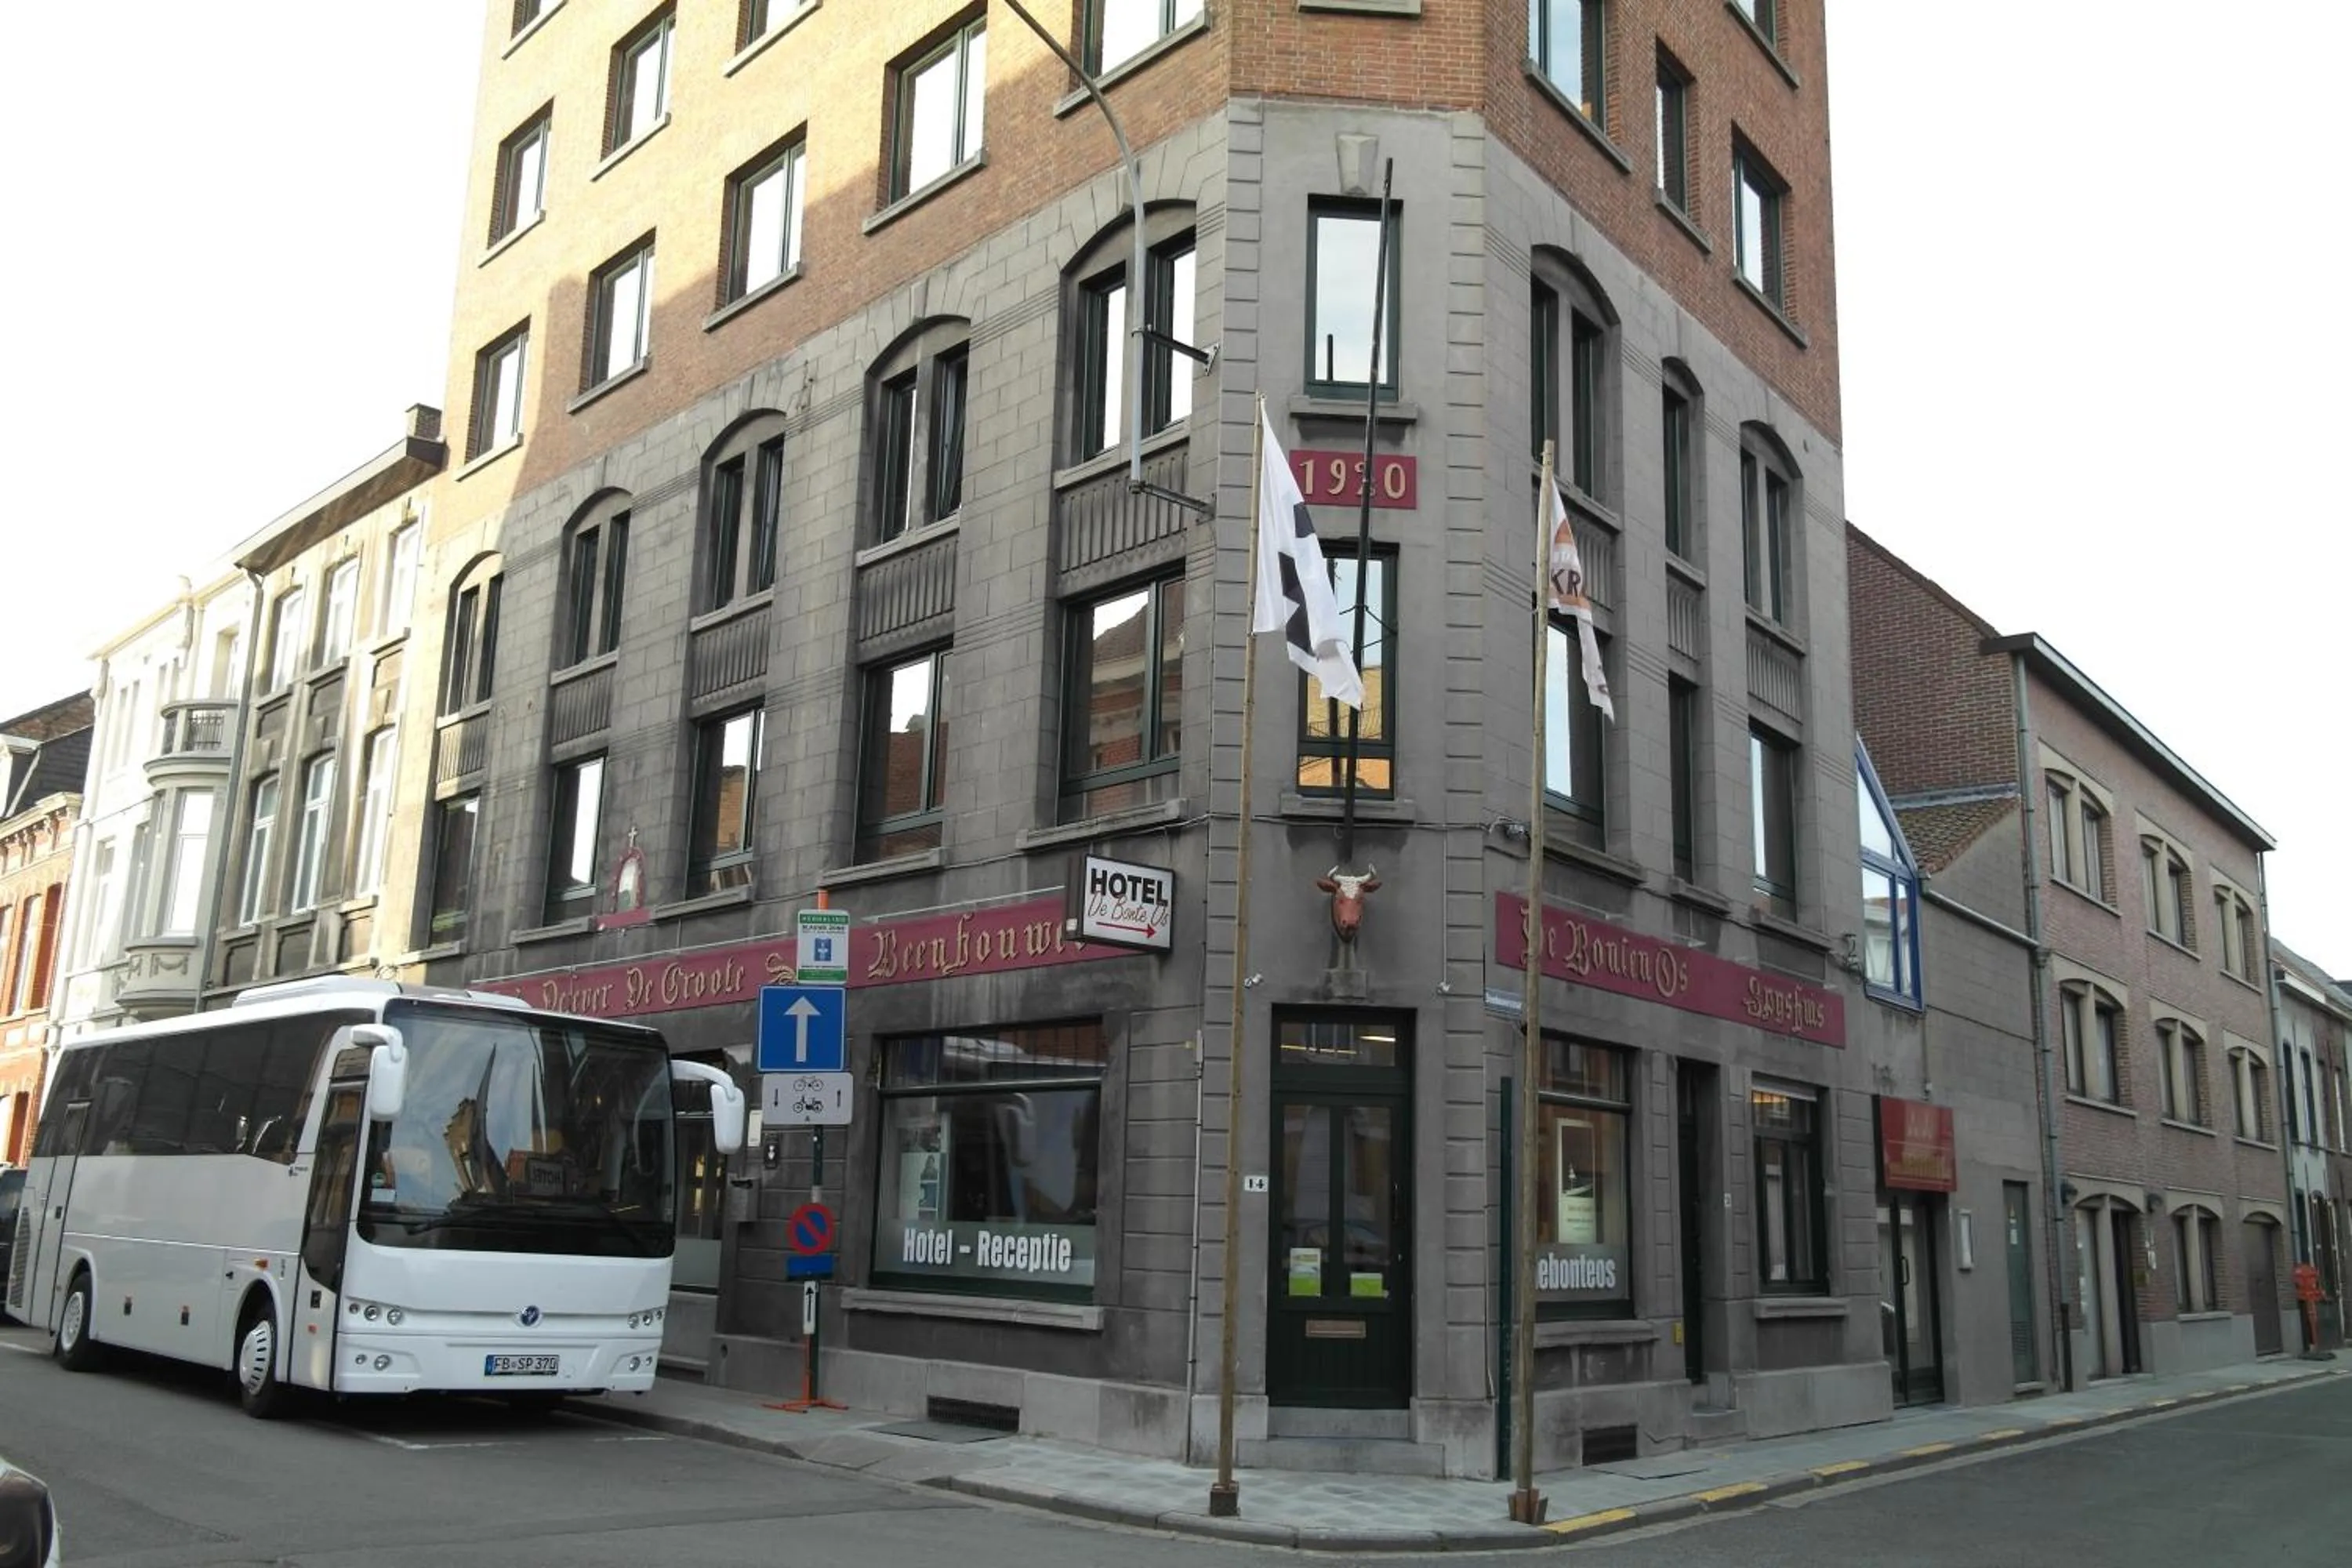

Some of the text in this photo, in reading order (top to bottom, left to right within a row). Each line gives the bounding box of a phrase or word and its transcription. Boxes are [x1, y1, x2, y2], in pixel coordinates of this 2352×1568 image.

[1091, 868, 1168, 906] HOTEL
[1087, 894, 1108, 917] De
[1111, 895, 1149, 923] Bonte
[867, 912, 1085, 979] Beenhouwe
[624, 967, 652, 1011] De
[1654, 947, 1688, 996] Os
[1249, 1178, 1264, 1189] 14
[902, 1228, 953, 1265] Hotel
[977, 1230, 1071, 1273] Receptie
[1536, 1252, 1616, 1290] ebonteos
